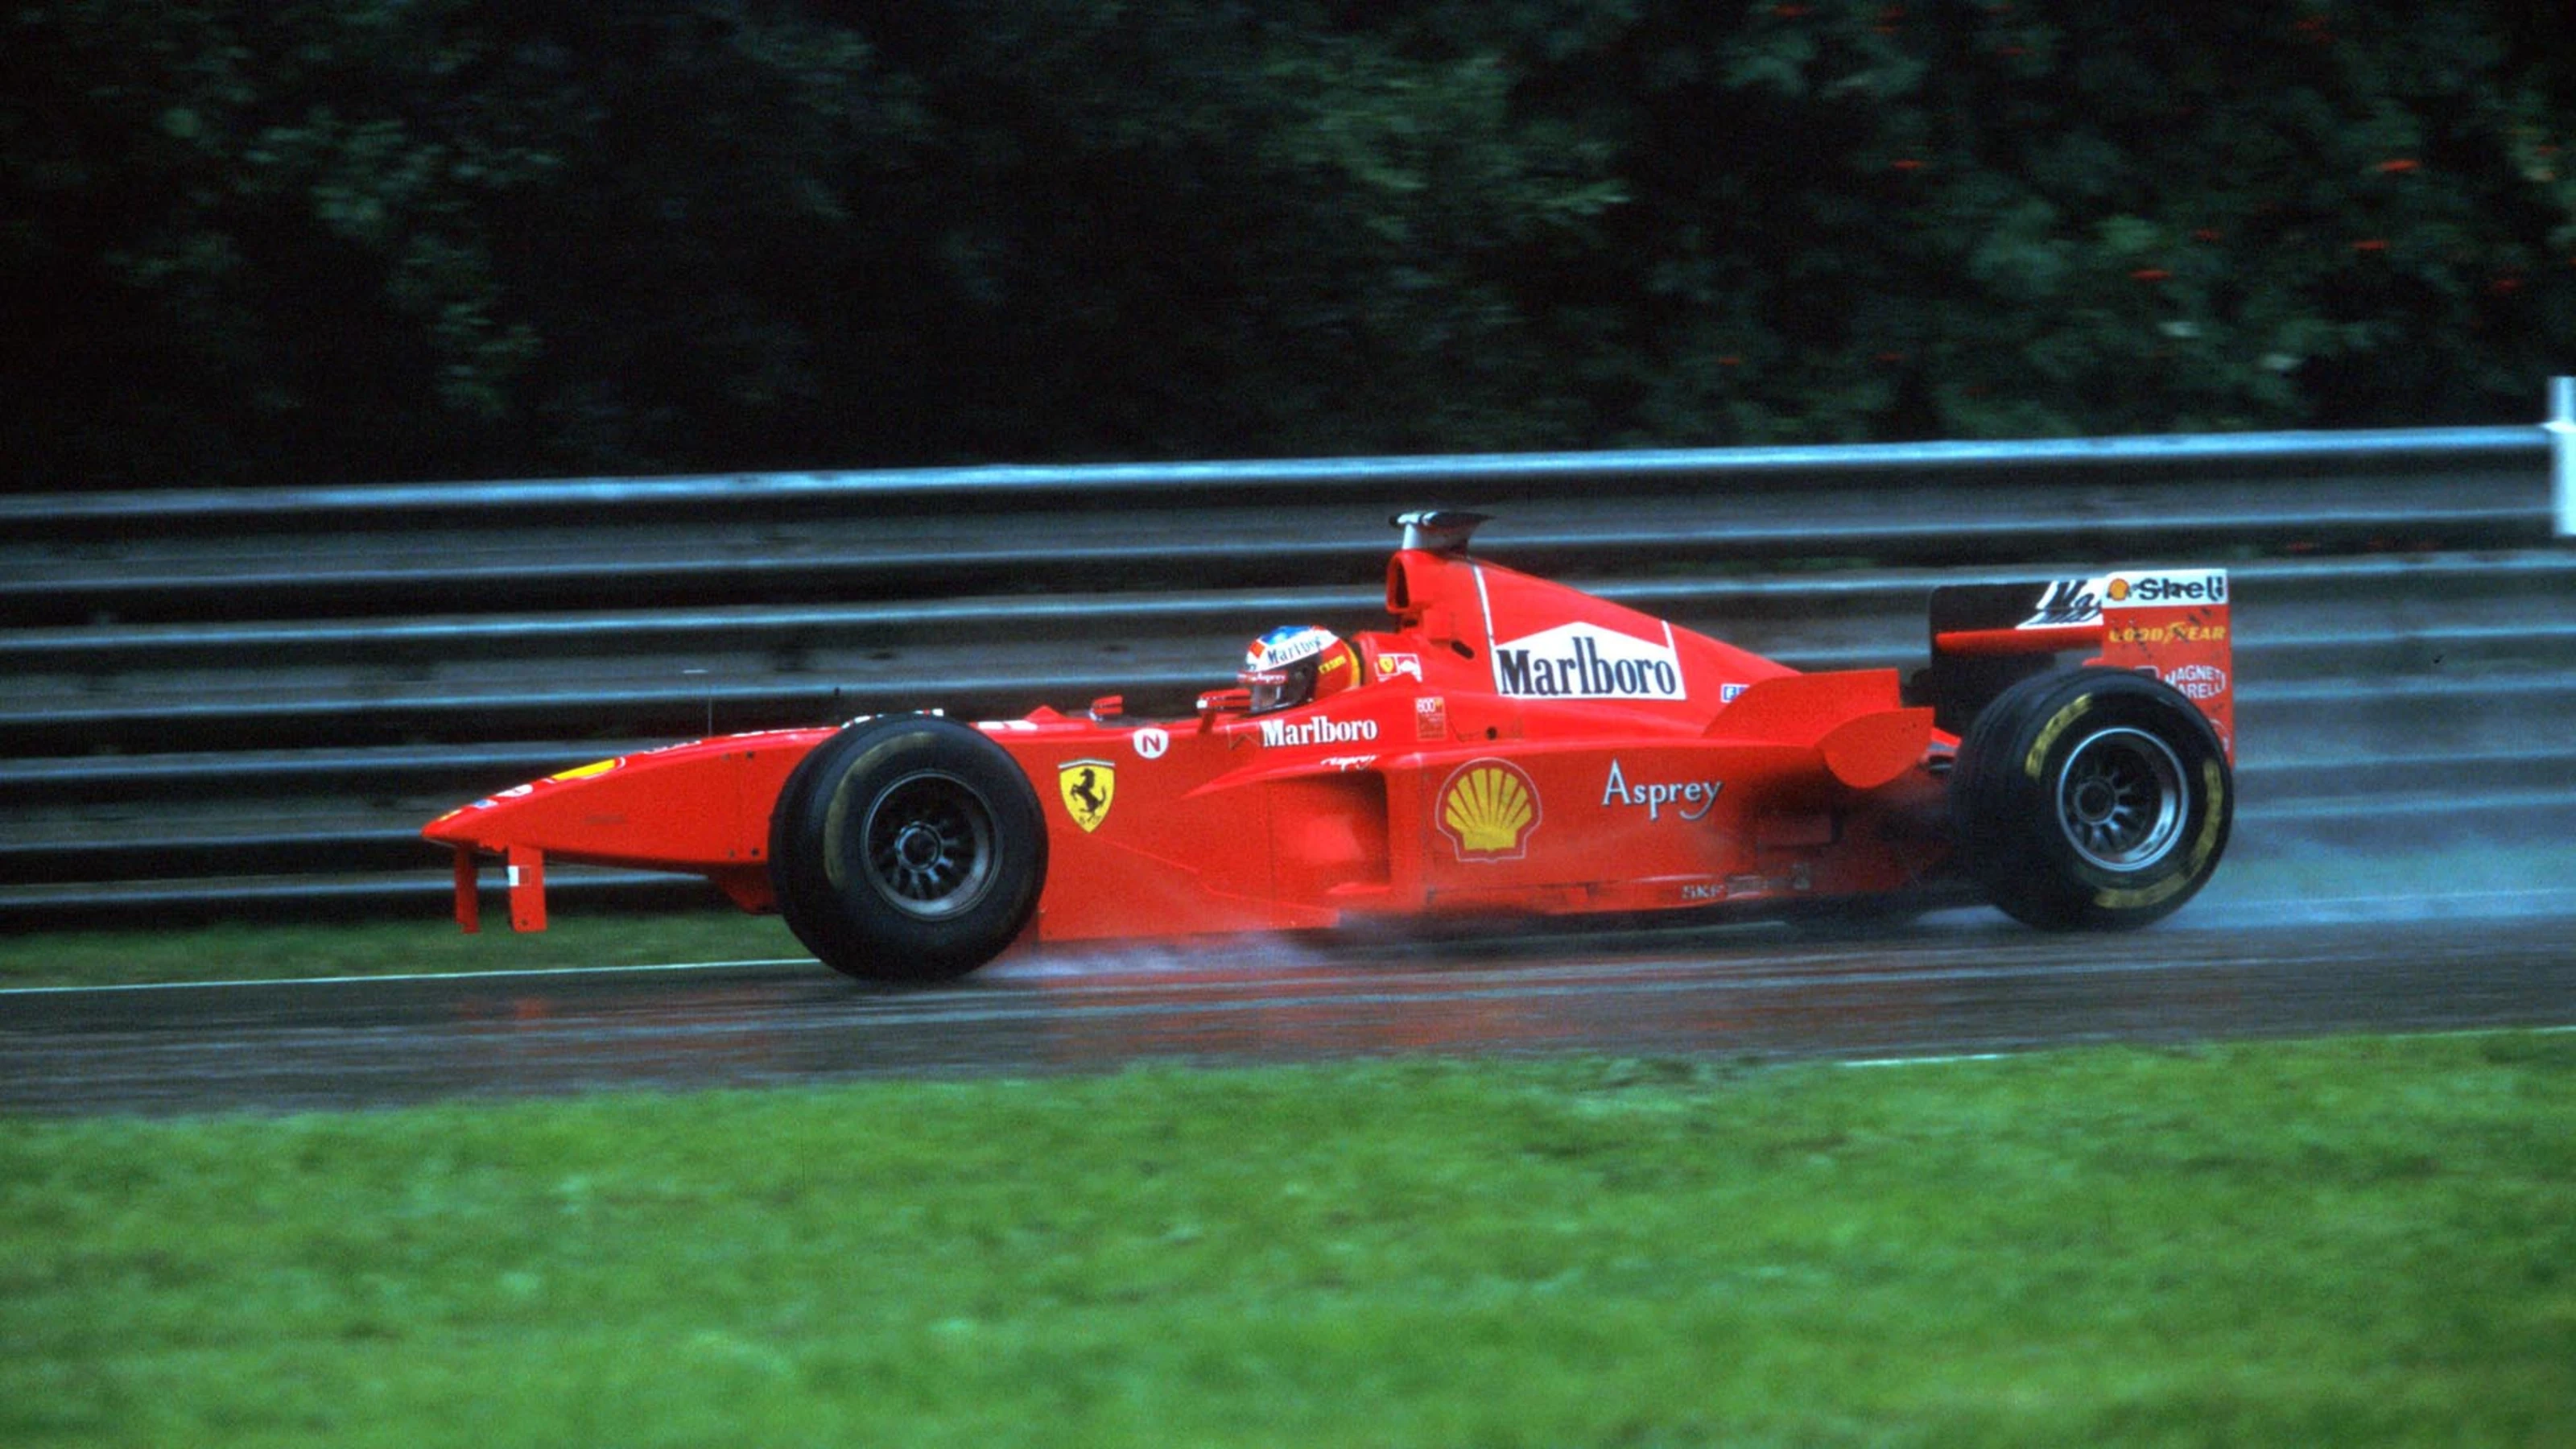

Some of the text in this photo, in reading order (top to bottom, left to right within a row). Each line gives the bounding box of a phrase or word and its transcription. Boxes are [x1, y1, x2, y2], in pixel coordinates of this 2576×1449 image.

[2138, 576, 2224, 601] Shell
[2108, 621, 2227, 644] GOODYEAR
[1496, 636, 1677, 696] Marlboro
[1142, 733, 1161, 753] N
[1259, 716, 1378, 747] Marlboro
[1601, 758, 1724, 820] Asprey
